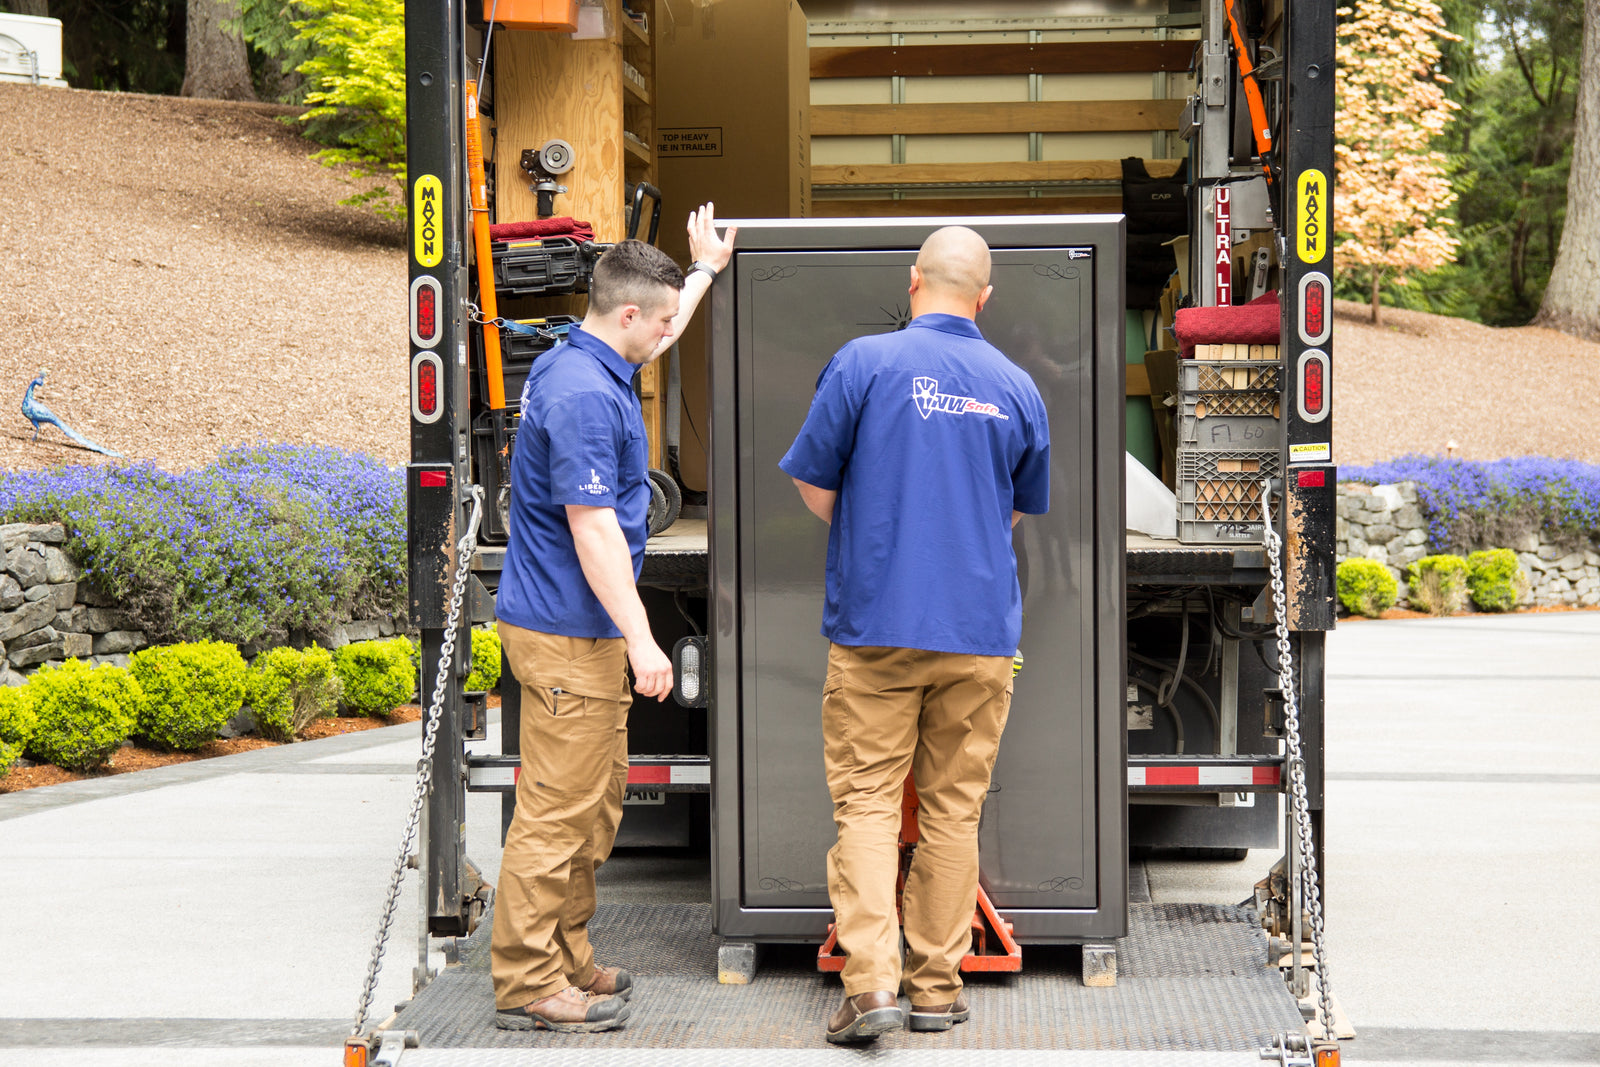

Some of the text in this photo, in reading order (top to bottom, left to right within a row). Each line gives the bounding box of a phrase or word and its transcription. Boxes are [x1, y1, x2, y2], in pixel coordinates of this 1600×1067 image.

[662, 133, 709, 142] TOP HEAVY
[670, 143, 679, 152] IN
[680, 143, 717, 151] TRAILER
[422, 187, 435, 255] MAXON
[1305, 181, 1319, 251] MAXON
[1216, 188, 1231, 307] ULTRA LI
[1243, 423, 1265, 440] 60
[579, 484, 610, 493] LIBERTY
